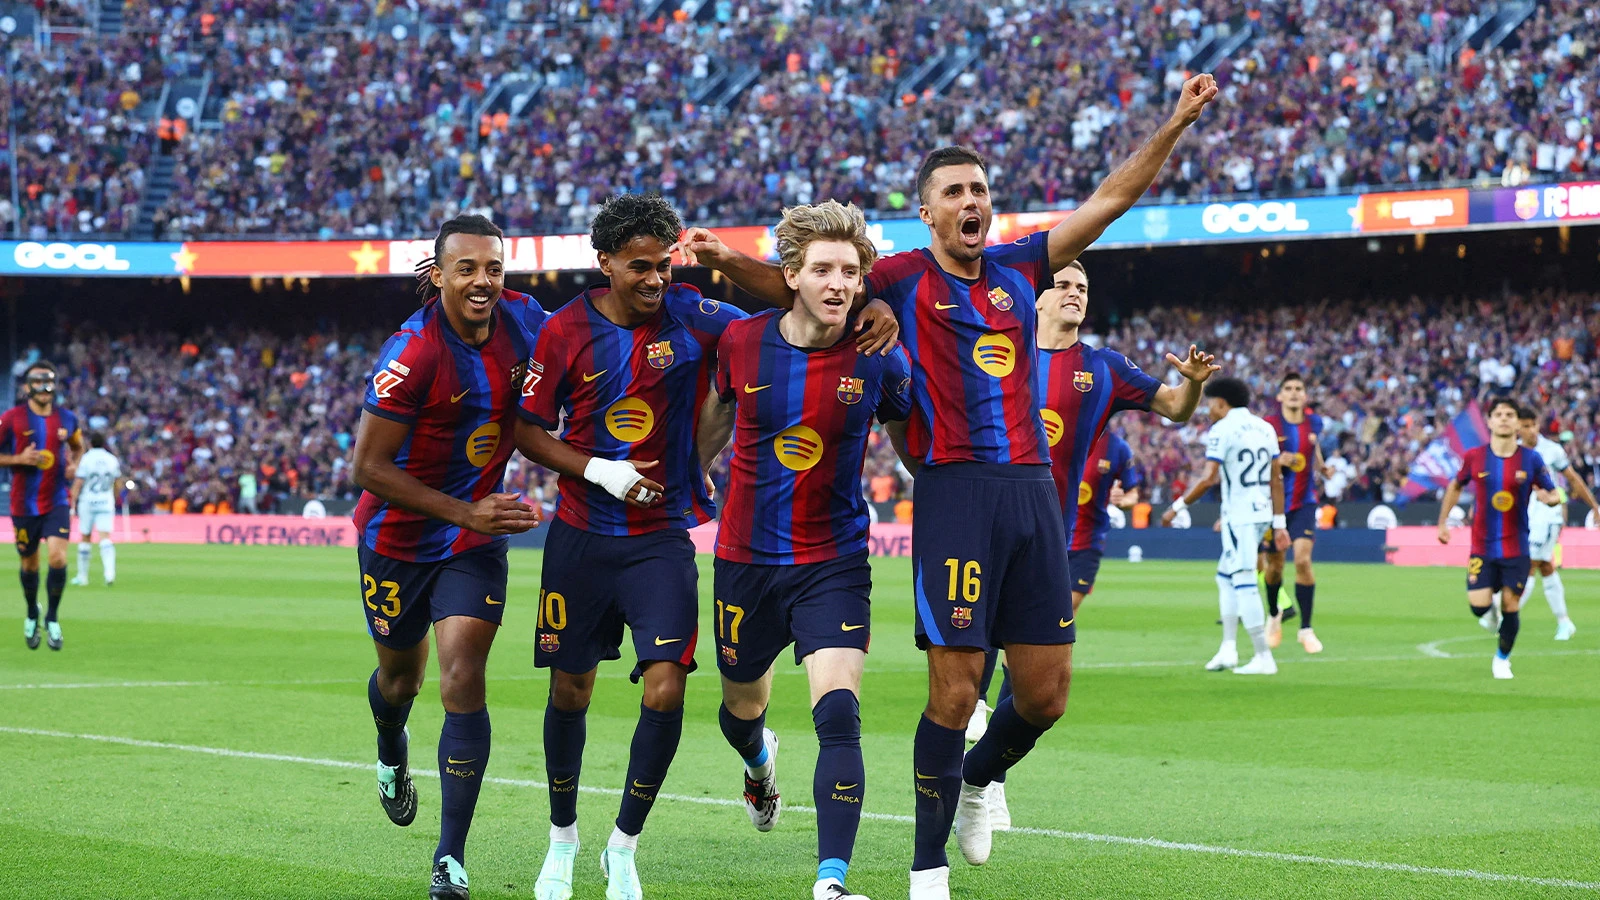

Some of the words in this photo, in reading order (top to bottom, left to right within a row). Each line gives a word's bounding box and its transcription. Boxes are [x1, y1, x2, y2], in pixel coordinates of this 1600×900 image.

[1202, 201, 1310, 234] GOOL
[1544, 186, 1568, 218] FC
[14, 241, 130, 271] GOOL
[1238, 447, 1271, 488] 22
[206, 524, 262, 545] LOVE
[266, 525, 345, 547] ENGINE
[868, 535, 911, 556] OVE
[363, 573, 401, 618] 23
[944, 558, 982, 603] 16
[538, 588, 568, 631] 10
[716, 599, 745, 644] 17
[445, 766, 476, 778] BARÇA
[831, 792, 860, 804] BARÇA
